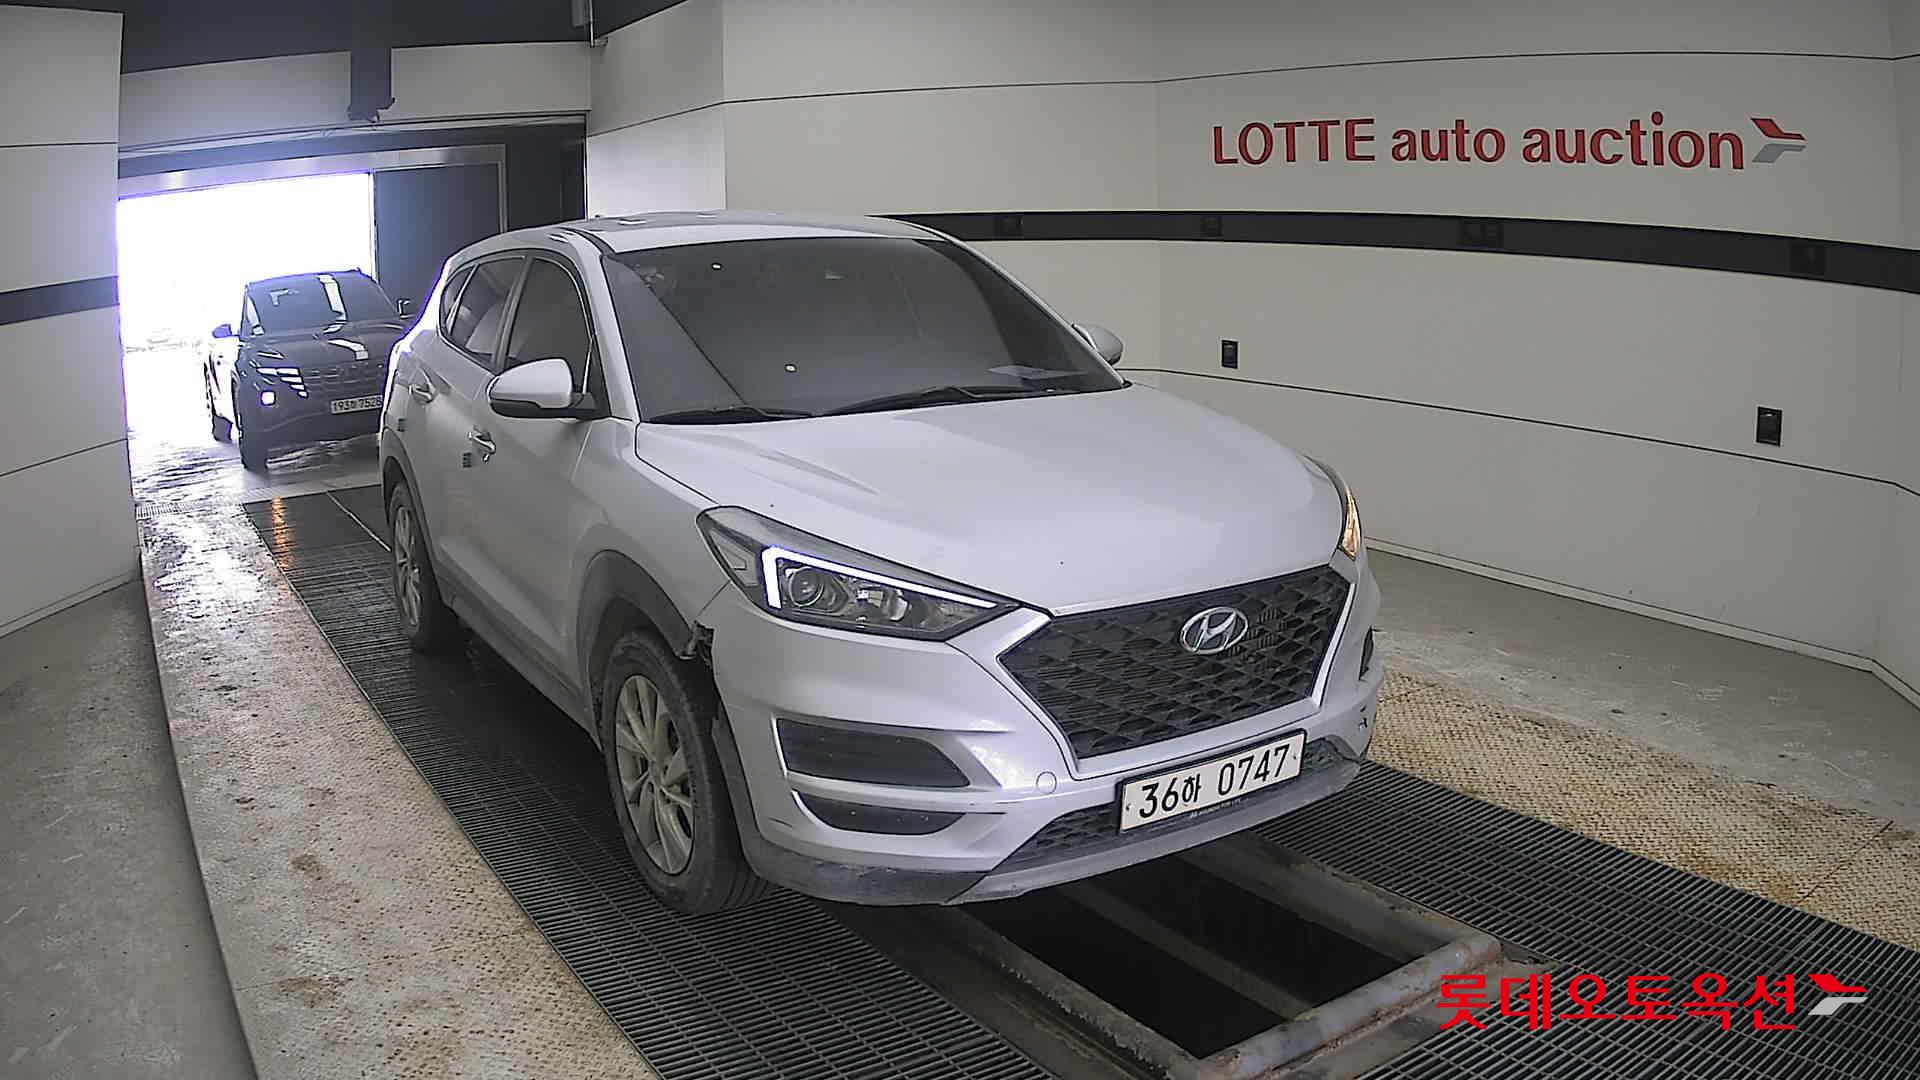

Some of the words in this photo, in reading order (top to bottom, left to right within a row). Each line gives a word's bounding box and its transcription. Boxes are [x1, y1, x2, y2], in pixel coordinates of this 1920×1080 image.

[1212, 118, 1375, 165] LOTTE
[1391, 118, 1506, 163] auto
[1522, 111, 1745, 170] auction
[1139, 773, 1202, 819] 36하
[1218, 743, 1291, 796] 0747
